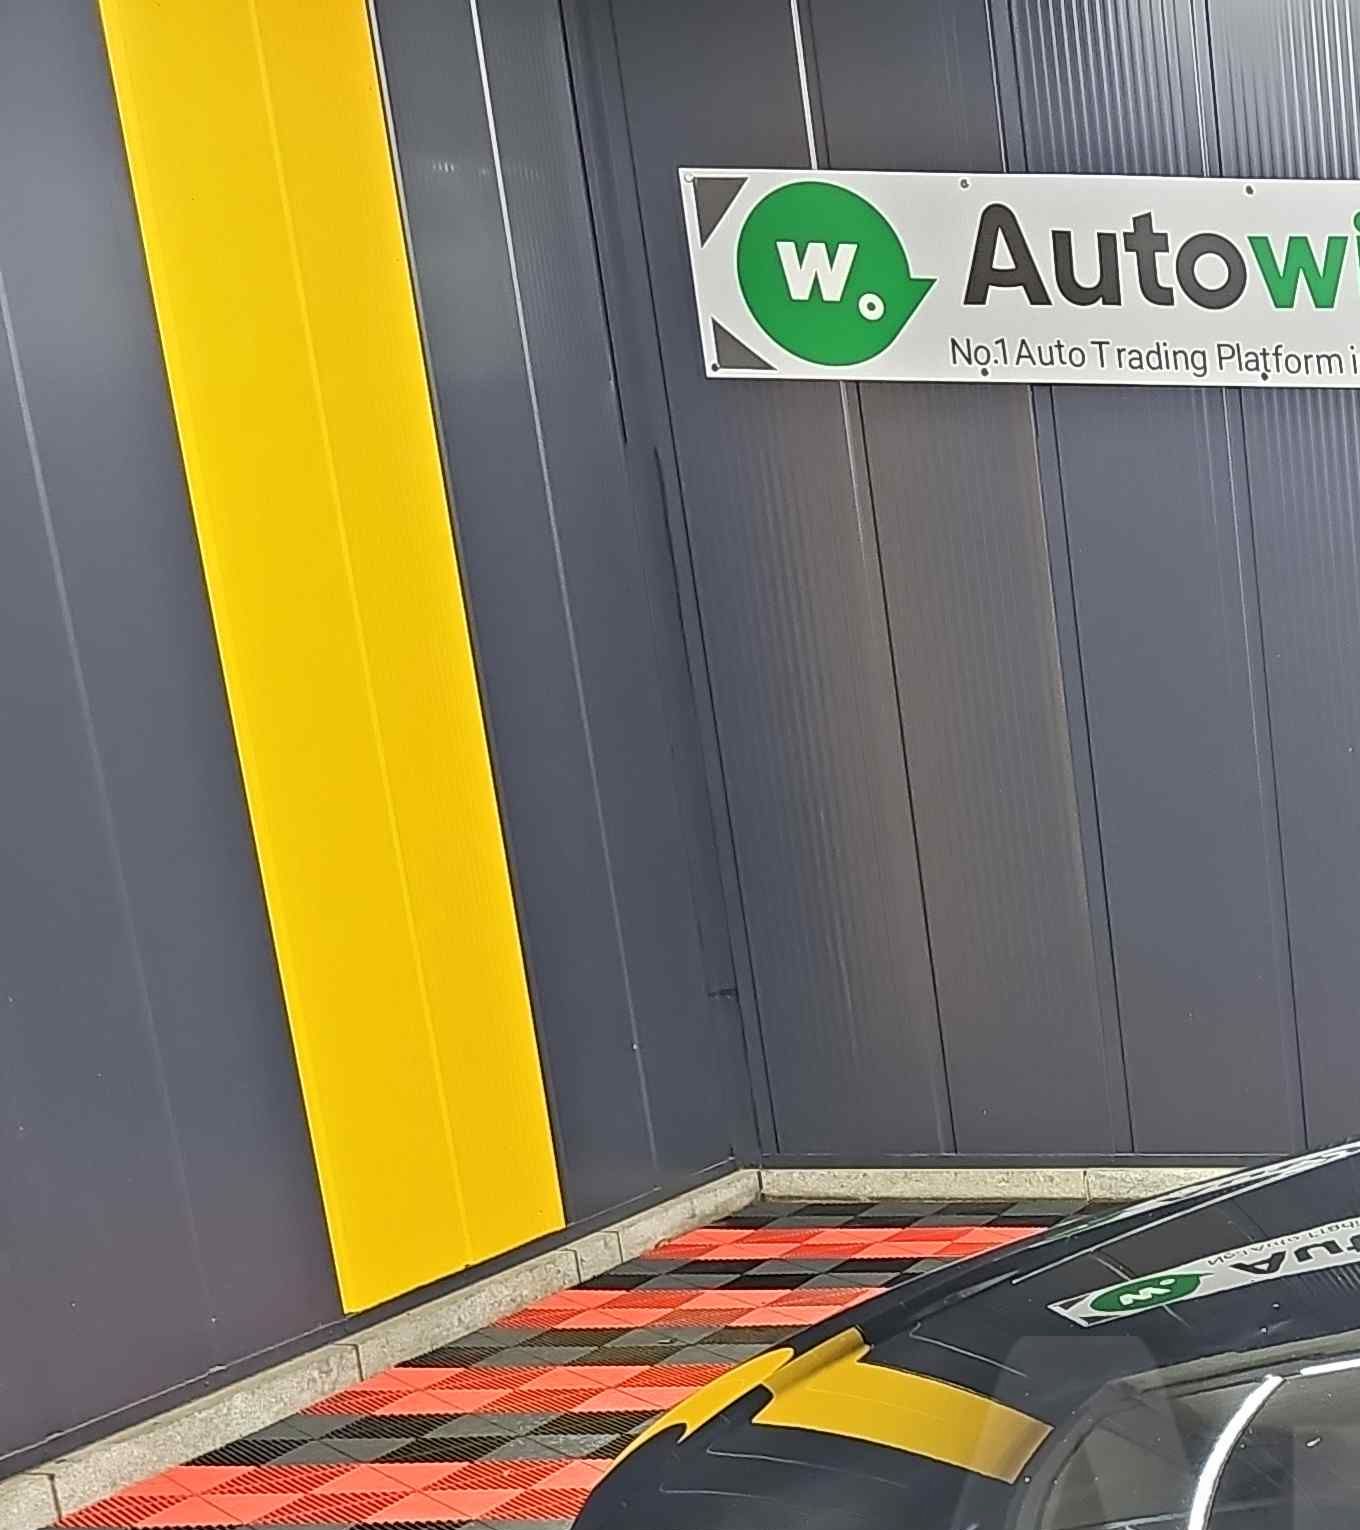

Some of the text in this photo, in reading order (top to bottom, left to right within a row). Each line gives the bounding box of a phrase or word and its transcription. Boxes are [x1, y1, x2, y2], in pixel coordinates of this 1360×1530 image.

[949, 336, 1008, 367] No.1
[1014, 338, 1087, 368] Auto
[1090, 340, 1208, 378] Trading
[1216, 342, 1344, 375] Platform
